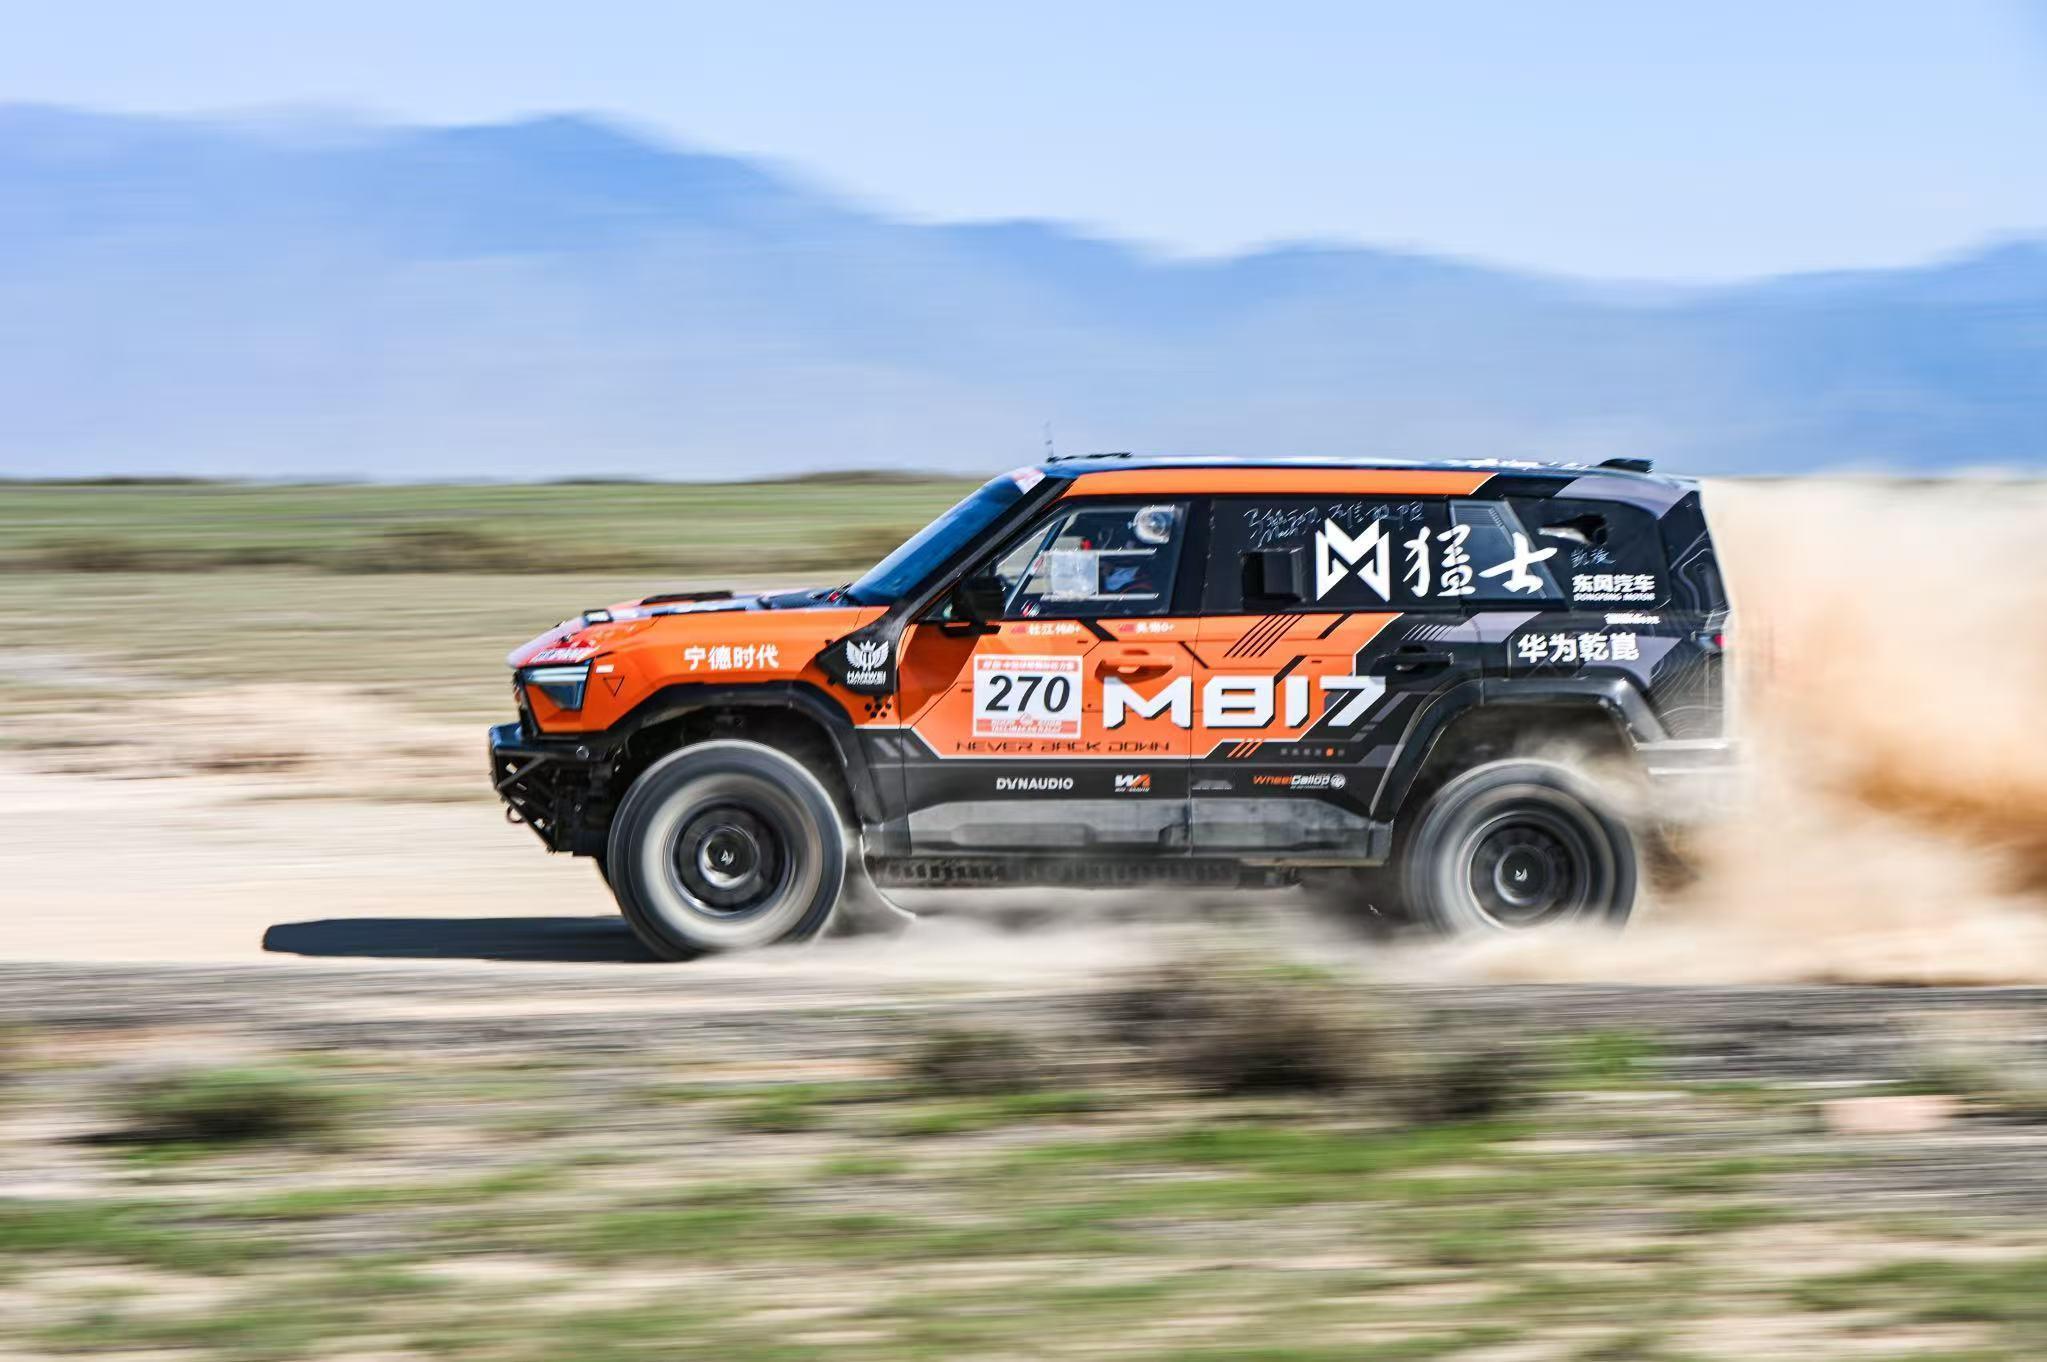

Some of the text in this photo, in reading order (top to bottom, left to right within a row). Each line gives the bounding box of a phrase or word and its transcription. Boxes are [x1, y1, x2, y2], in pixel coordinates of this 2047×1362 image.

[1403, 524, 1558, 597] 猛士
[1572, 574, 1656, 593] 东风汽车
[684, 645, 779, 671] 宁德时代
[1517, 632, 1639, 663] 华为乾崑
[985, 675, 1070, 713] 270
[1103, 676, 1386, 729] M817
[996, 777, 1074, 791] DYNAUDIO
